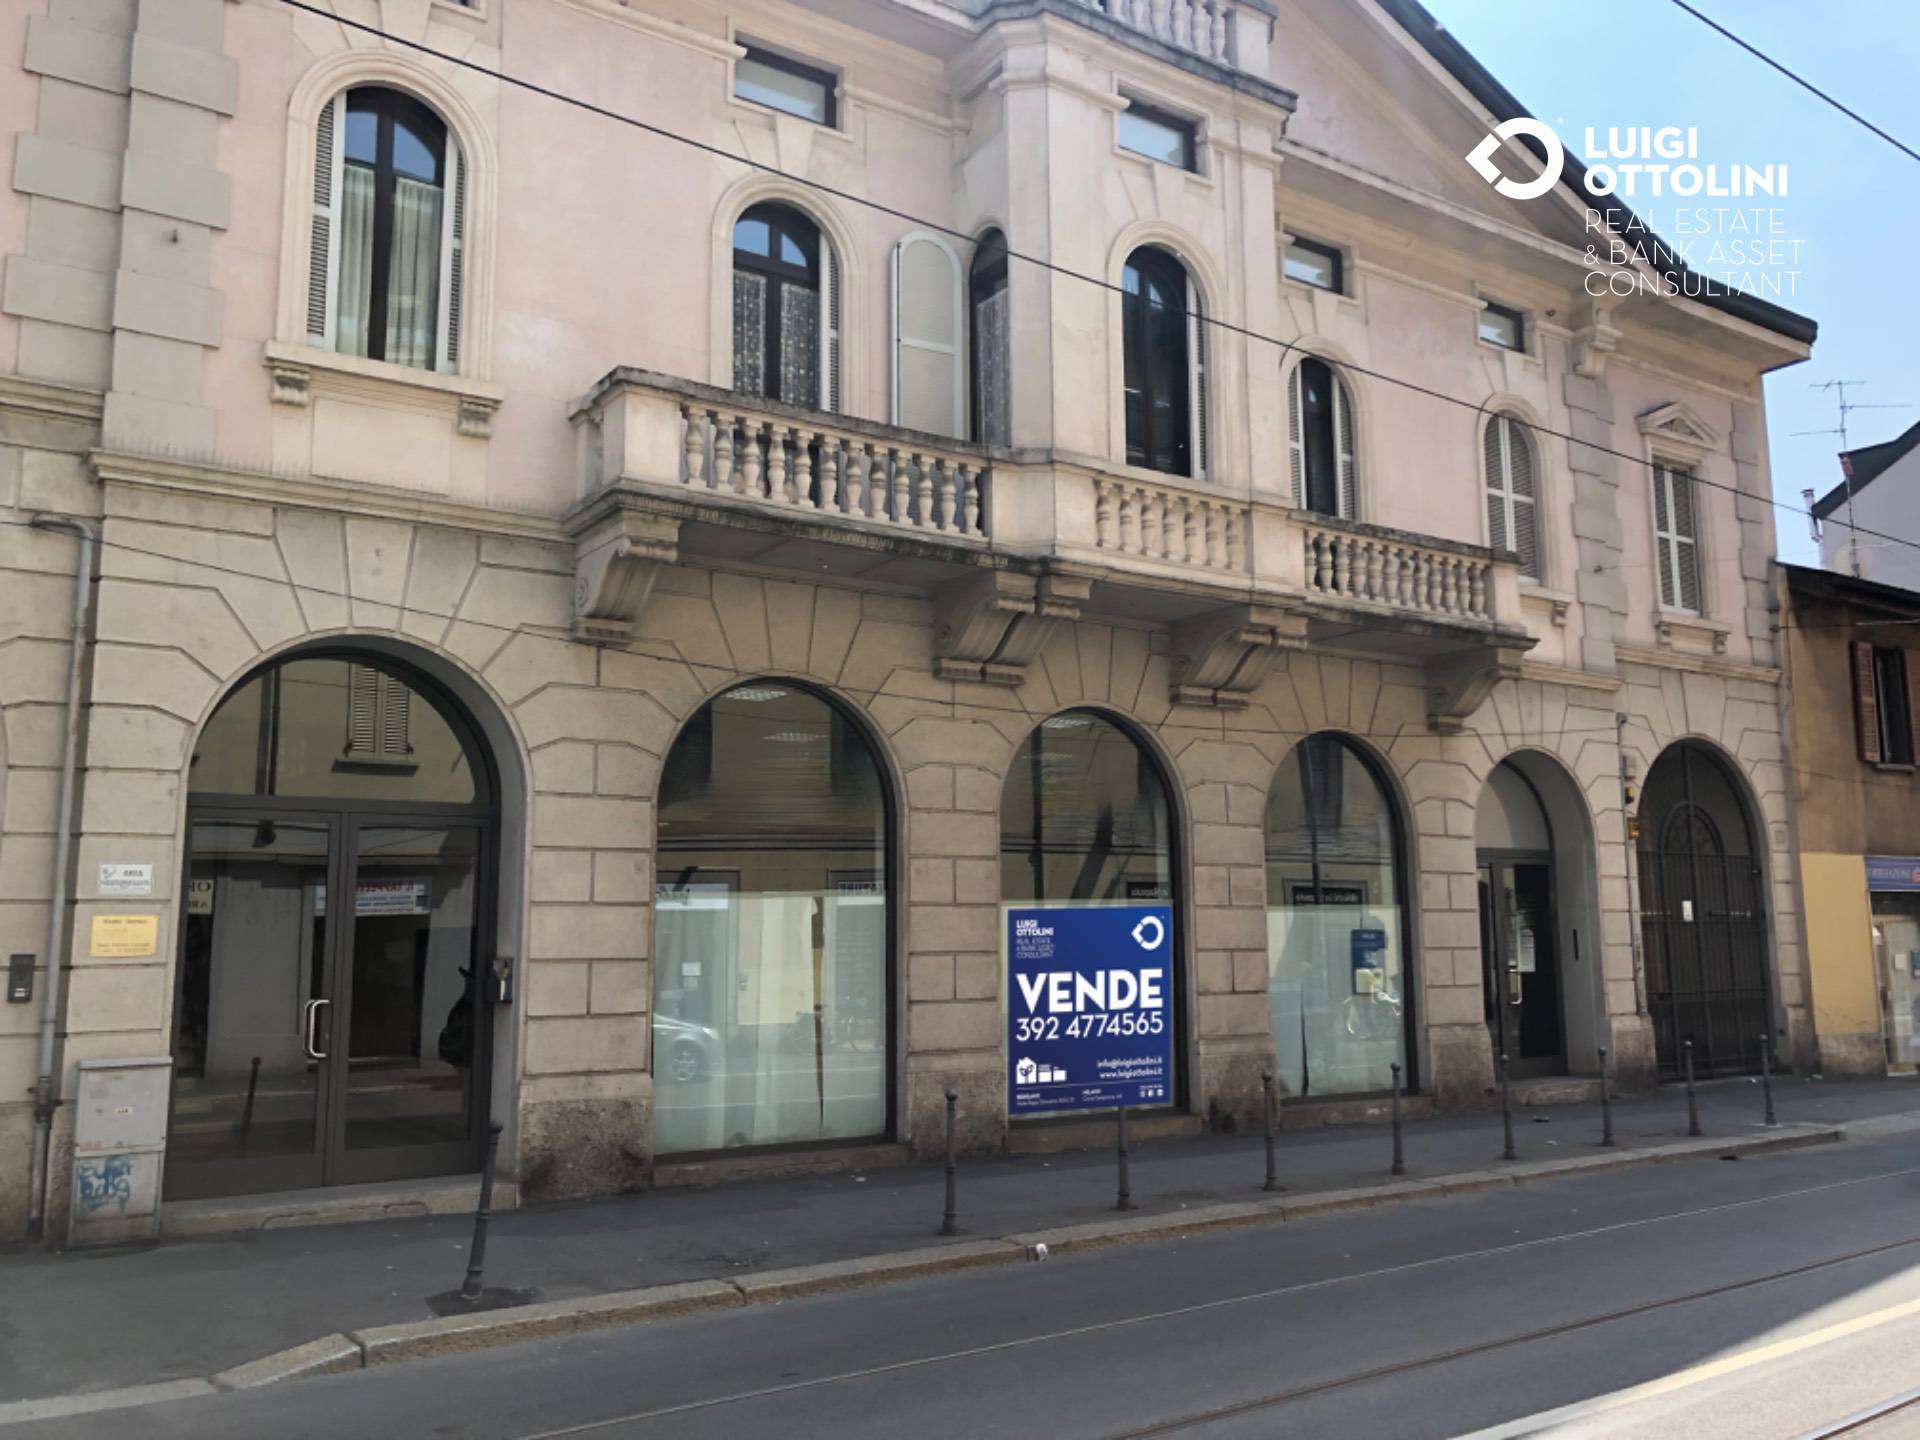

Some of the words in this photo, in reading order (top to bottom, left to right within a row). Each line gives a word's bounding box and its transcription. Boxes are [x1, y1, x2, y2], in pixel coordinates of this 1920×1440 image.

[1016, 919, 1038, 928] LUIGI
[1016, 927, 1054, 936] OTTOLINI
[1016, 968, 1163, 1014] VENDE
[1016, 1016, 1059, 1041] 392
[1065, 1011, 1163, 1039] 4774565
